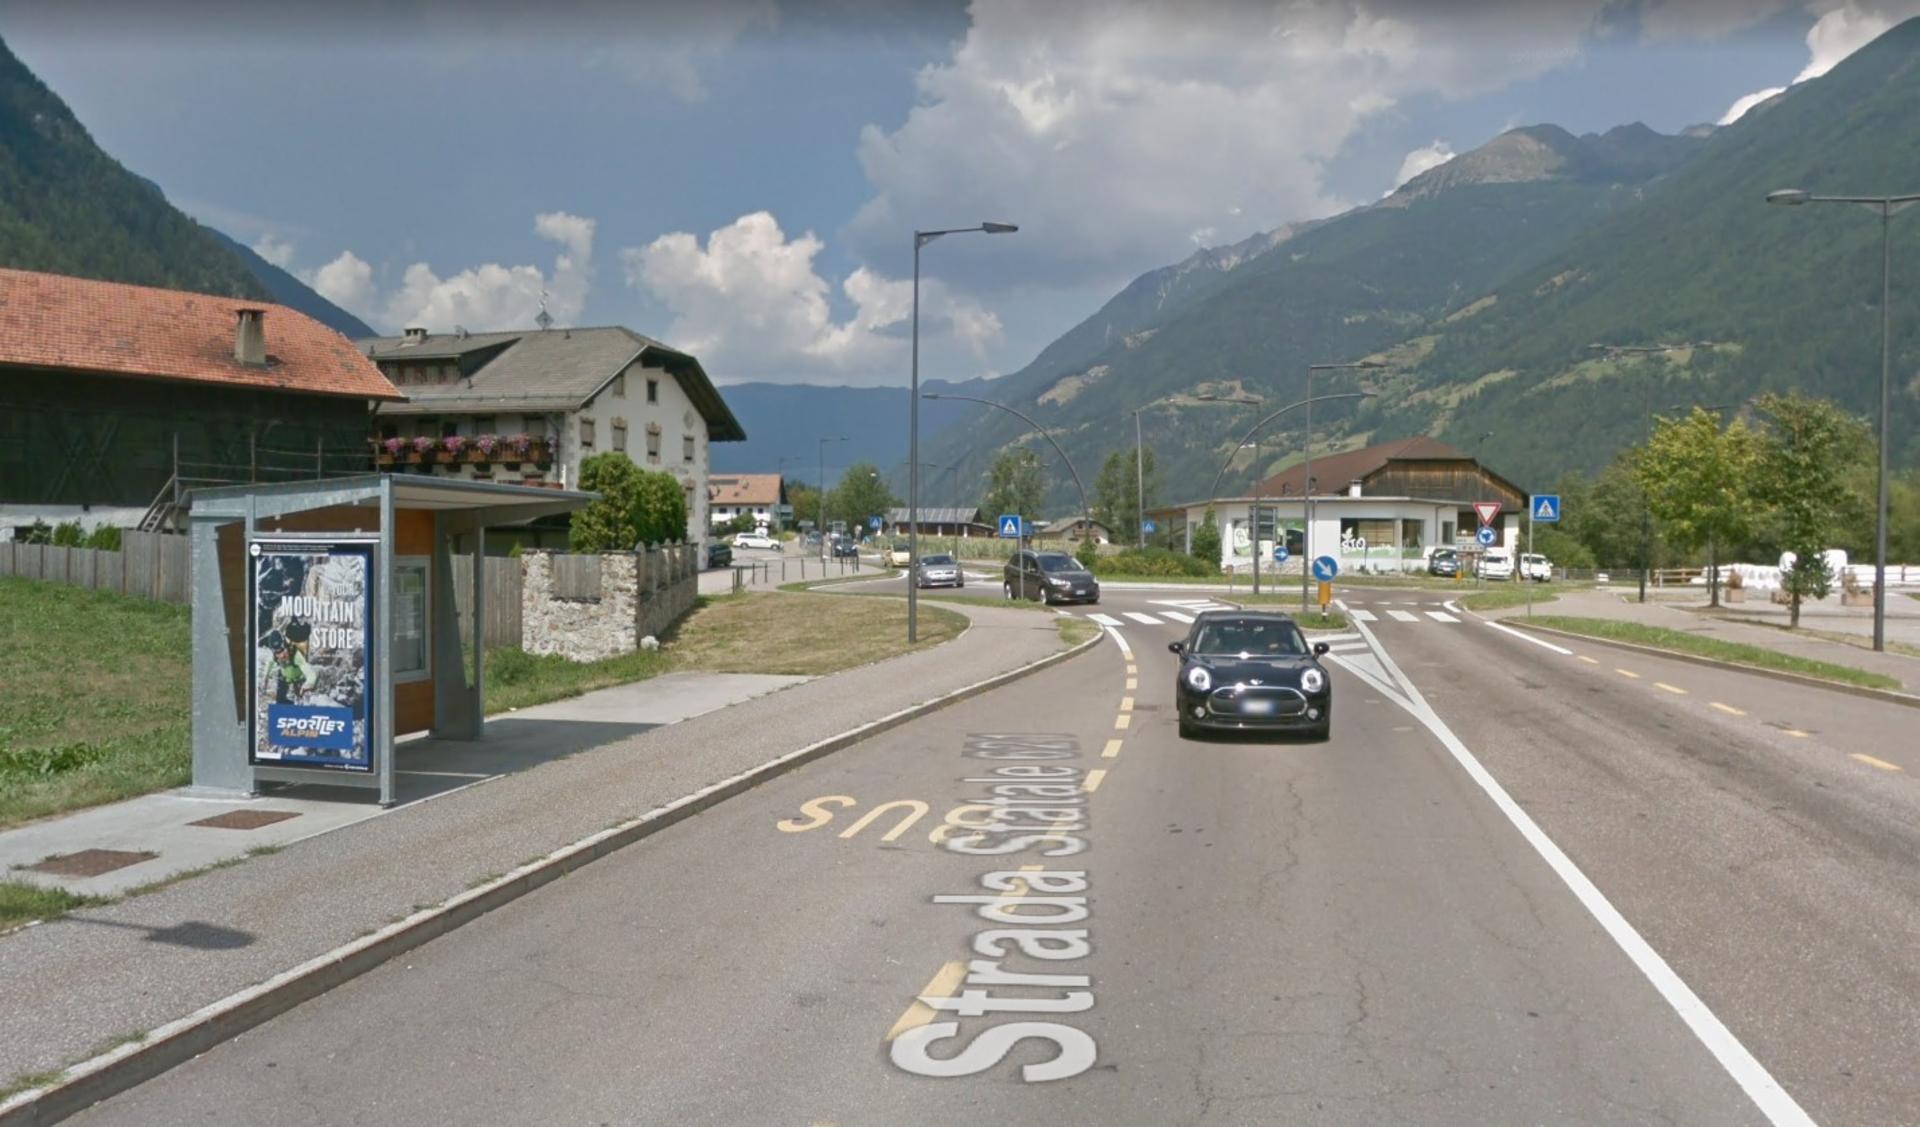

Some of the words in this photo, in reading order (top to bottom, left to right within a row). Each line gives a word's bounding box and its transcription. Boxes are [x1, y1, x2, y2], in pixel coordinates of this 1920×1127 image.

[281, 595, 354, 623] MOUNTAIN
[312, 627, 353, 649] STORE
[276, 715, 346, 735] SPORTLER
[777, 795, 996, 844] BUS
